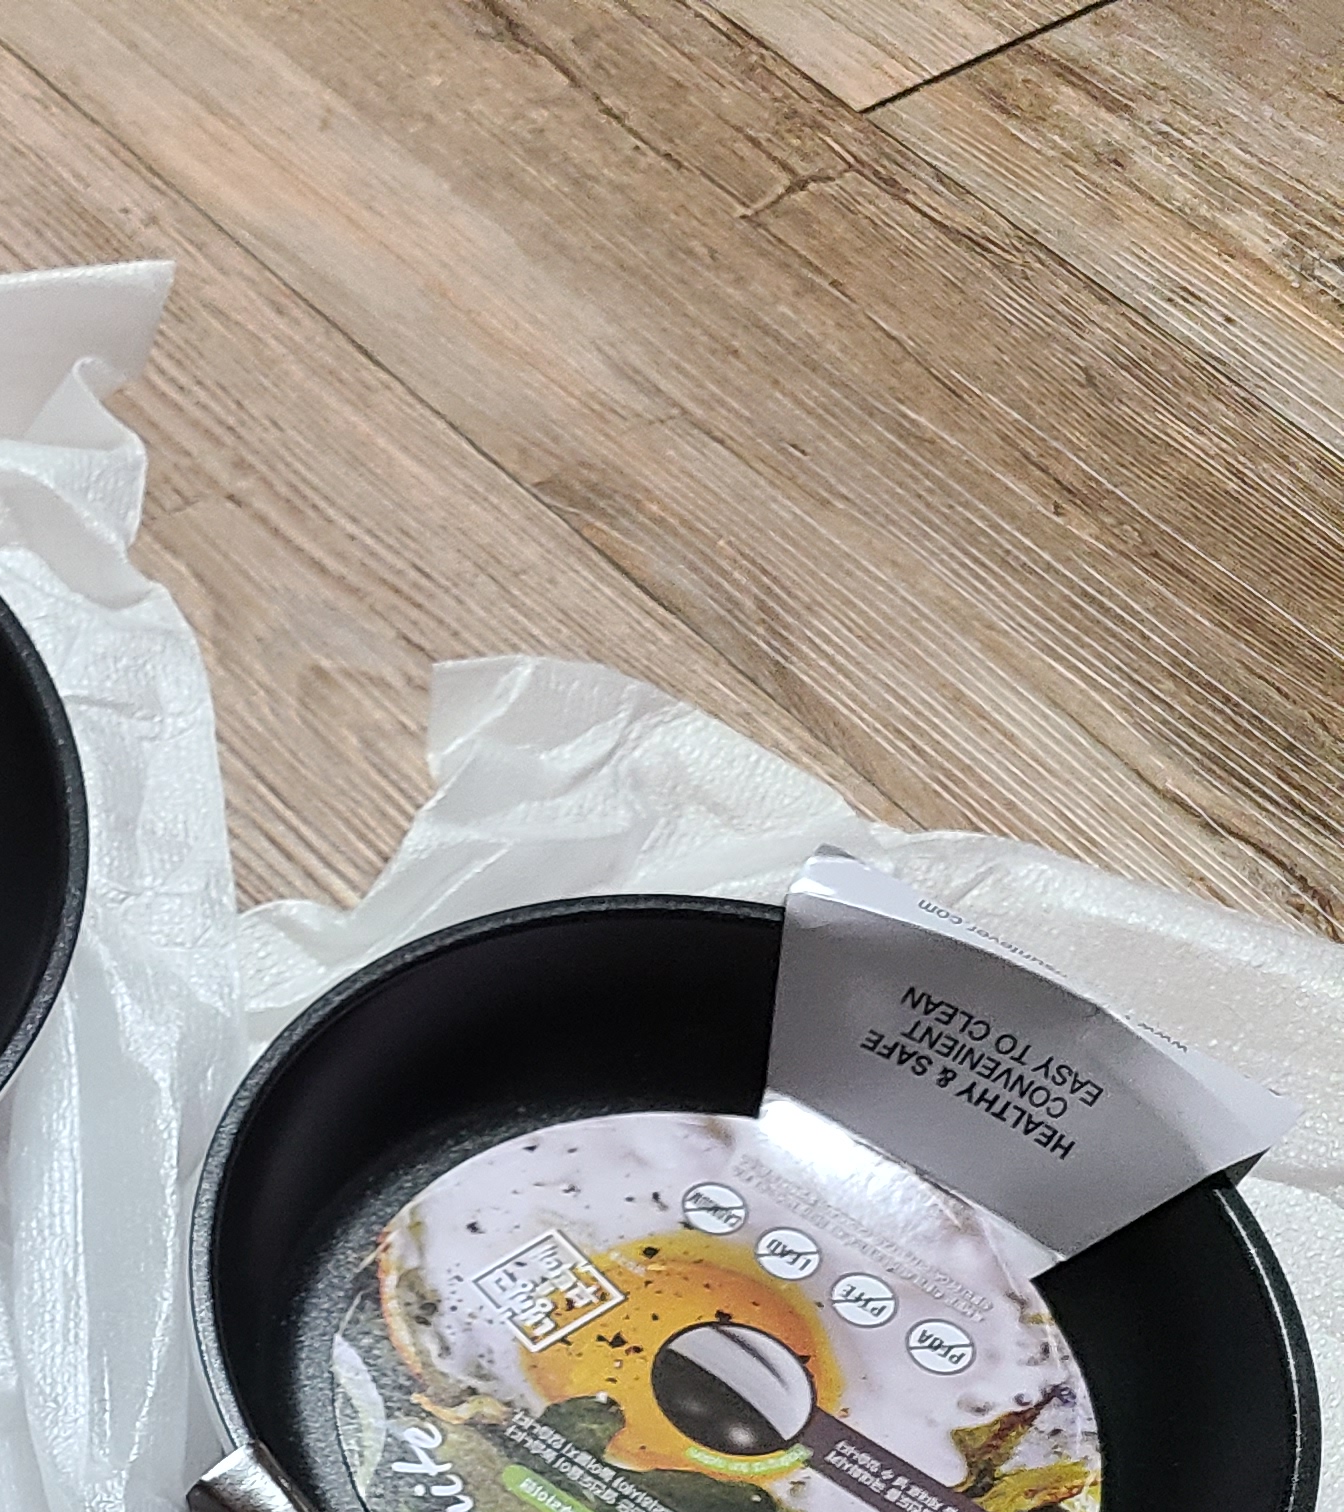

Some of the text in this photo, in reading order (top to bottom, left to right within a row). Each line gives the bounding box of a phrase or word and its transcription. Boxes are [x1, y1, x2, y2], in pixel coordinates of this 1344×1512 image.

[859, 1023, 1078, 1161] HEALTHY & SAFE
[898, 980, 1106, 1109] EASY TO CLEAN
[899, 1012, 1071, 1123] CONVENIENT
